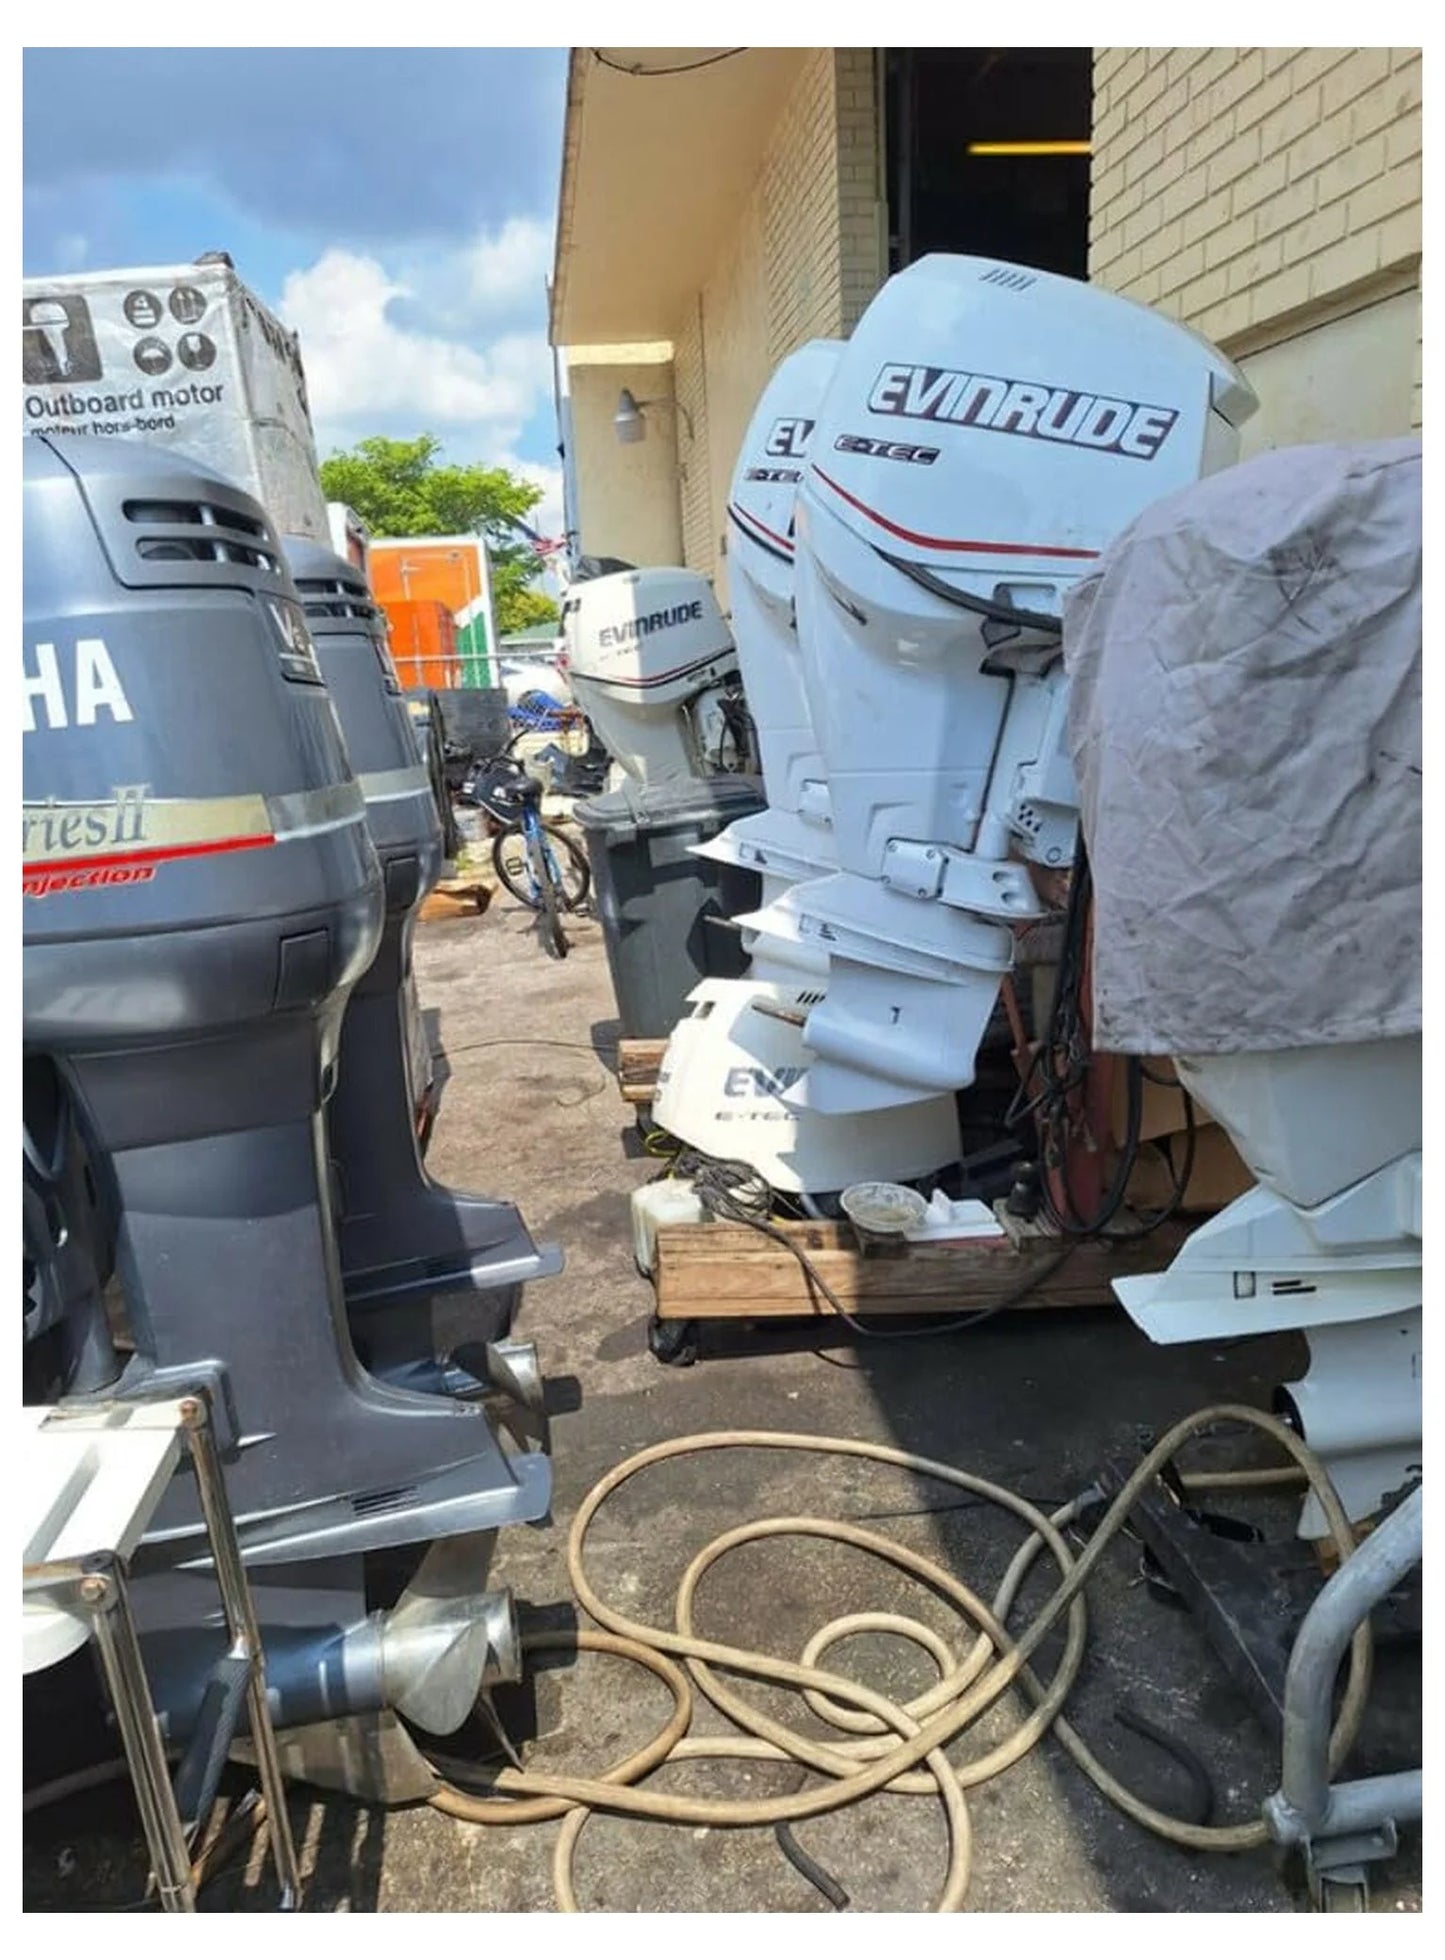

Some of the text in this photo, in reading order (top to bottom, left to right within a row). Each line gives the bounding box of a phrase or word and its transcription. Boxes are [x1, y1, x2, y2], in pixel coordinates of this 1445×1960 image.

[25, 383, 225, 418] Outboard motor
[867, 362, 1180, 460] EVINRUDE
[93, 414, 176, 436] hors-bord
[833, 433, 941, 466] E-TEC
[598, 600, 703, 648] EVINRUDE
